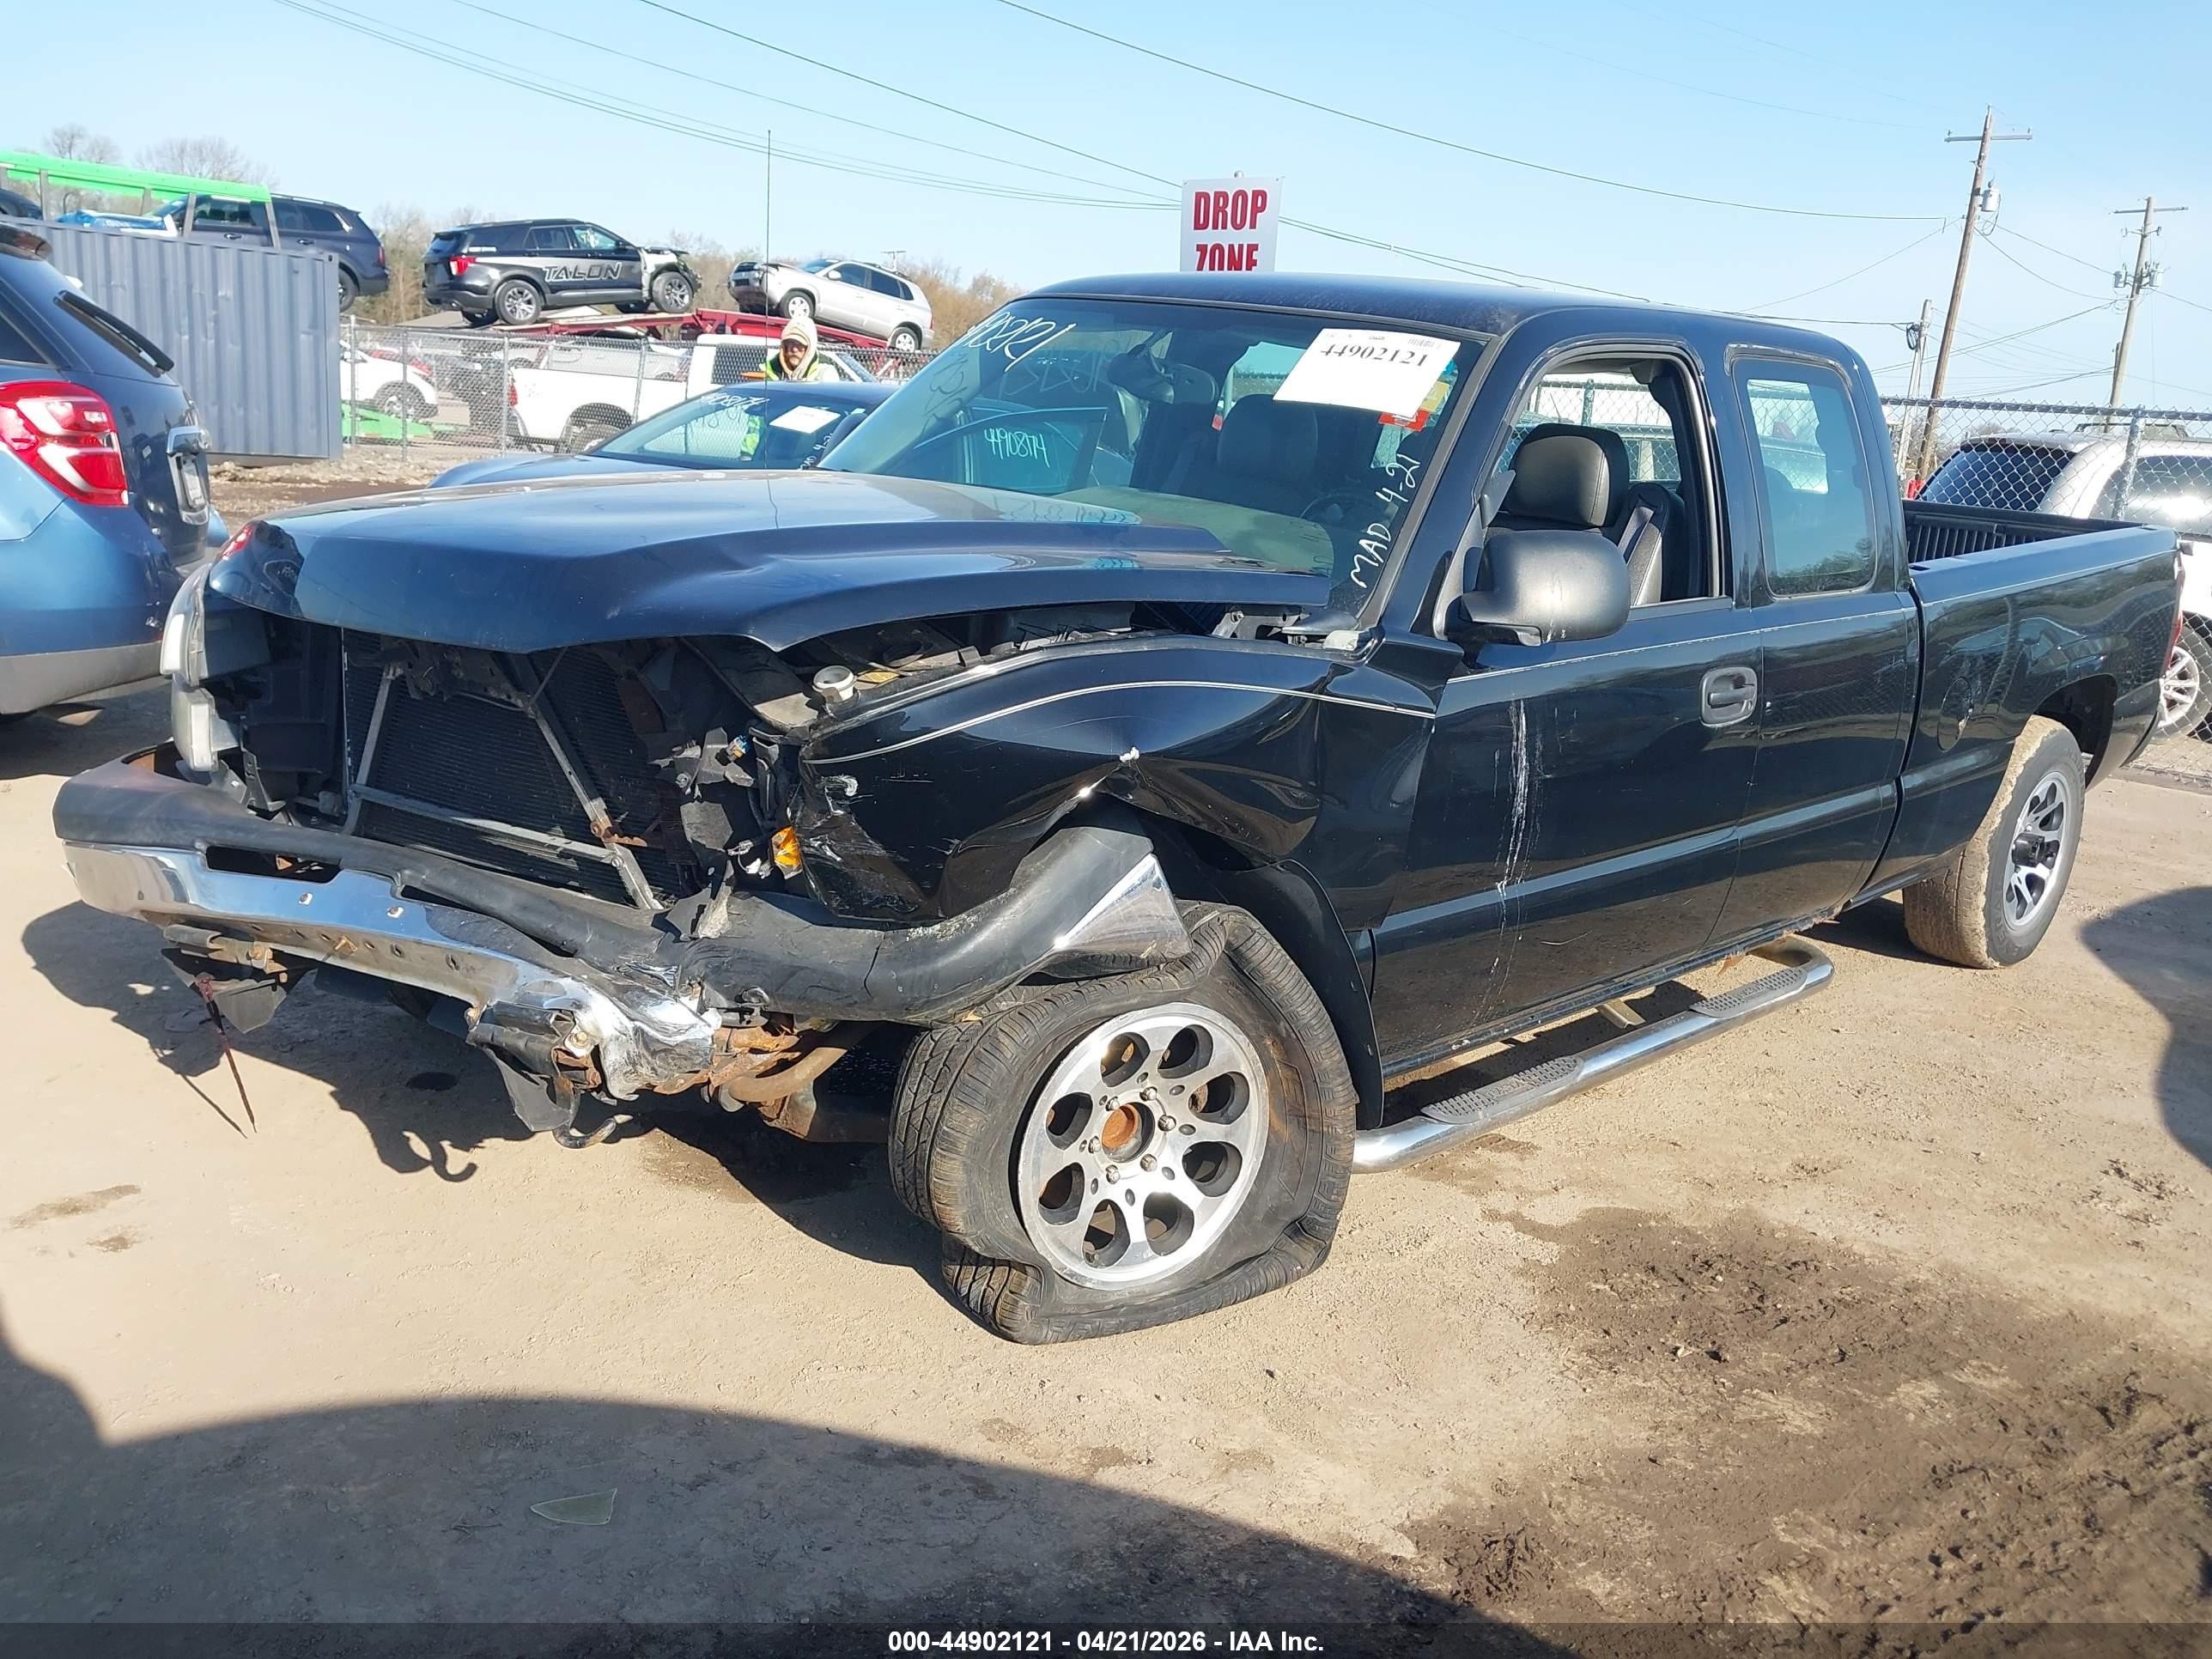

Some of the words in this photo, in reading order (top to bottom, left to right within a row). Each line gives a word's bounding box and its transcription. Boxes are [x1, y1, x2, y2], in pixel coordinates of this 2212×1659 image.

[1193, 189, 1268, 230] DROP
[1195, 242, 1260, 271] ZONE
[543, 261, 623, 283] TALON
[1320, 343, 1428, 367] 44902121
[1350, 523, 1392, 588] MAD
[1375, 453, 1421, 502] 4-21
